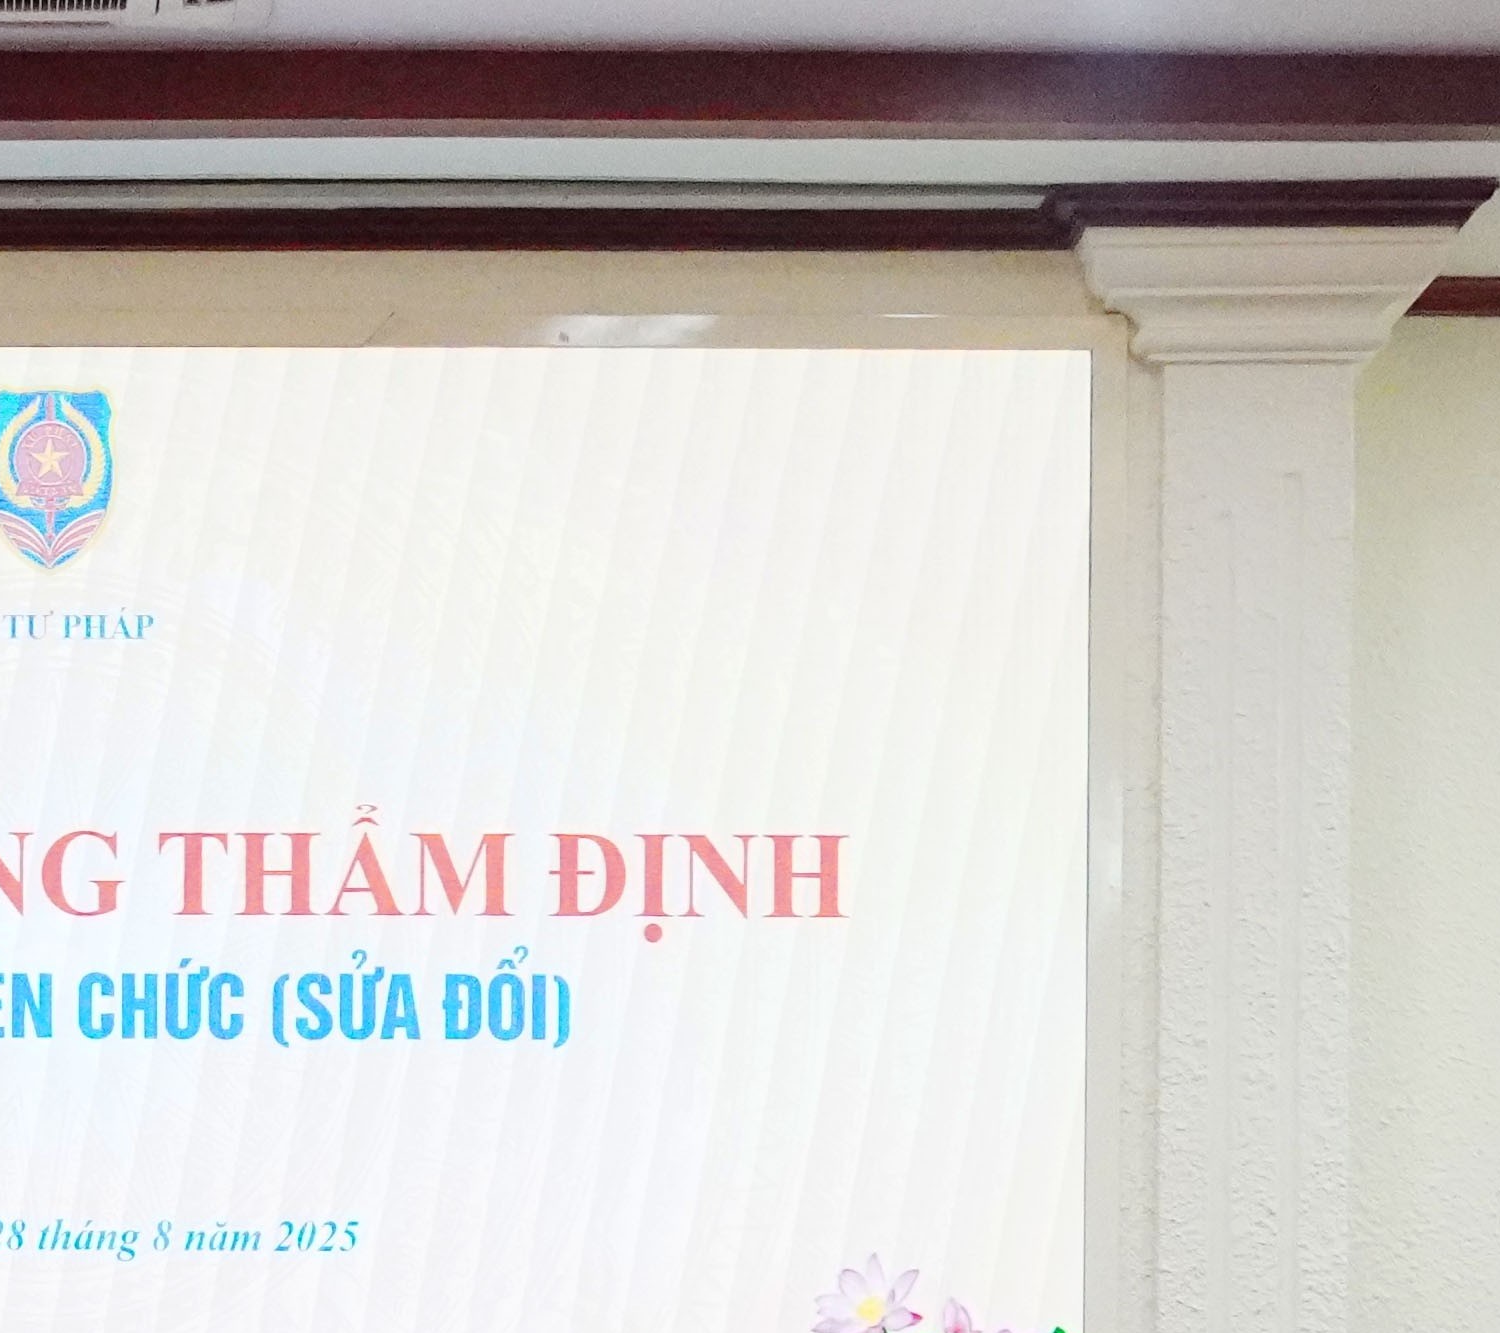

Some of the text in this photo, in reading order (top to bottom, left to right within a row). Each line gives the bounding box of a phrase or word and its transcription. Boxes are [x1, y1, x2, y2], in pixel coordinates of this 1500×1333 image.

[3, 610, 54, 640] TƯ
[64, 606, 154, 640] PHÁP
[158, 804, 515, 918] THẨM
[548, 832, 850, 943] ĐỊNH
[77, 957, 245, 1041] CHỨC
[273, 949, 422, 1048] (SỬA
[442, 945, 571, 1048] ĐỔI)
[37, 1218, 141, 1262] tháng
[153, 1219, 173, 1252] 8
[184, 1221, 263, 1252] năm
[274, 1220, 360, 1252] 2025
